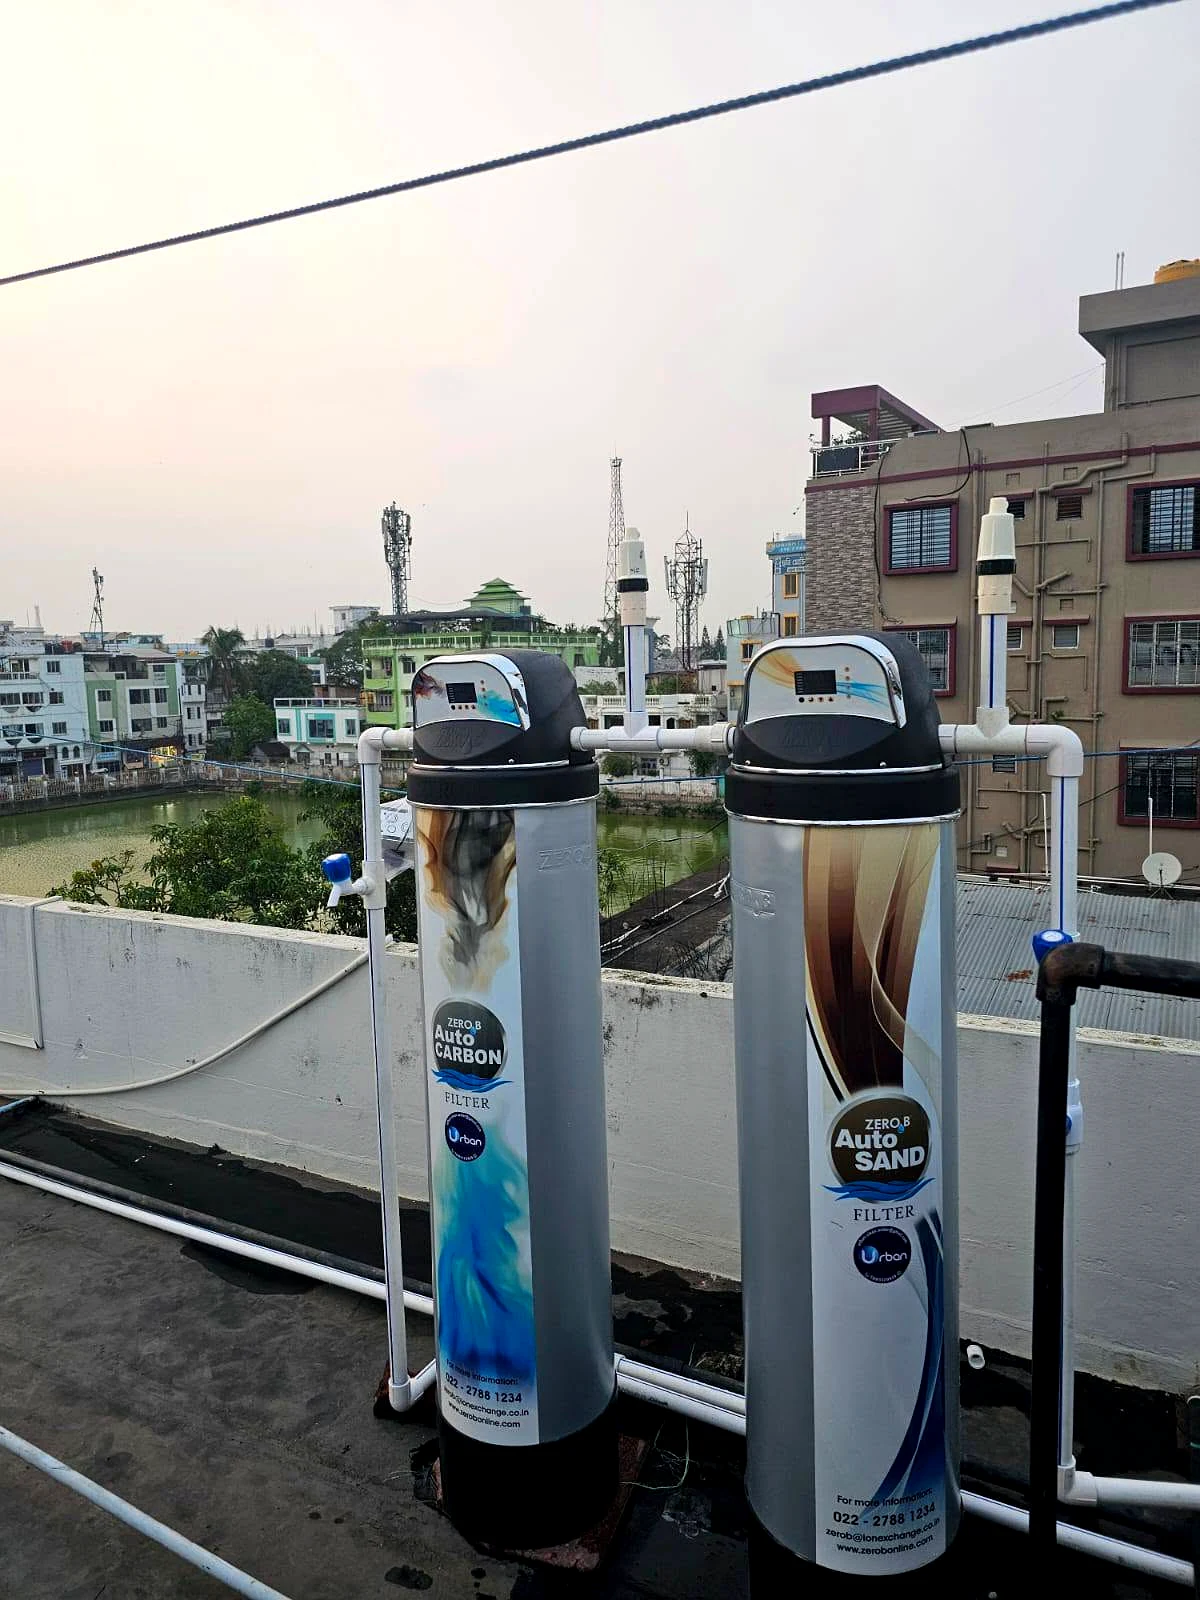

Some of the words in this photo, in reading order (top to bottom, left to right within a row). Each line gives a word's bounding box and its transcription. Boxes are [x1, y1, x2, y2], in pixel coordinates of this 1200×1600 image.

[447, 1017, 473, 1030] ZERO
[474, 1020, 482, 1030] B
[434, 1024, 475, 1047] Auto
[434, 1041, 502, 1065] CARBON
[444, 1091, 490, 1110] FILTER
[865, 1117, 901, 1131] ZERO
[903, 1116, 911, 1127] B
[834, 1128, 898, 1150] Auto
[854, 1146, 925, 1171] SAND
[853, 1205, 915, 1222] FILTER
[861, 1247, 908, 1265] Urban
[445, 1372, 459, 1389] 022
[466, 1385, 491, 1401] 2788
[495, 1392, 522, 1404] 1234
[837, 1494, 851, 1505] For
[854, 1499, 880, 1508] more
[833, 1511, 859, 1526] 022
[872, 1513, 905, 1527] 2788
[909, 1502, 936, 1522] 1234
